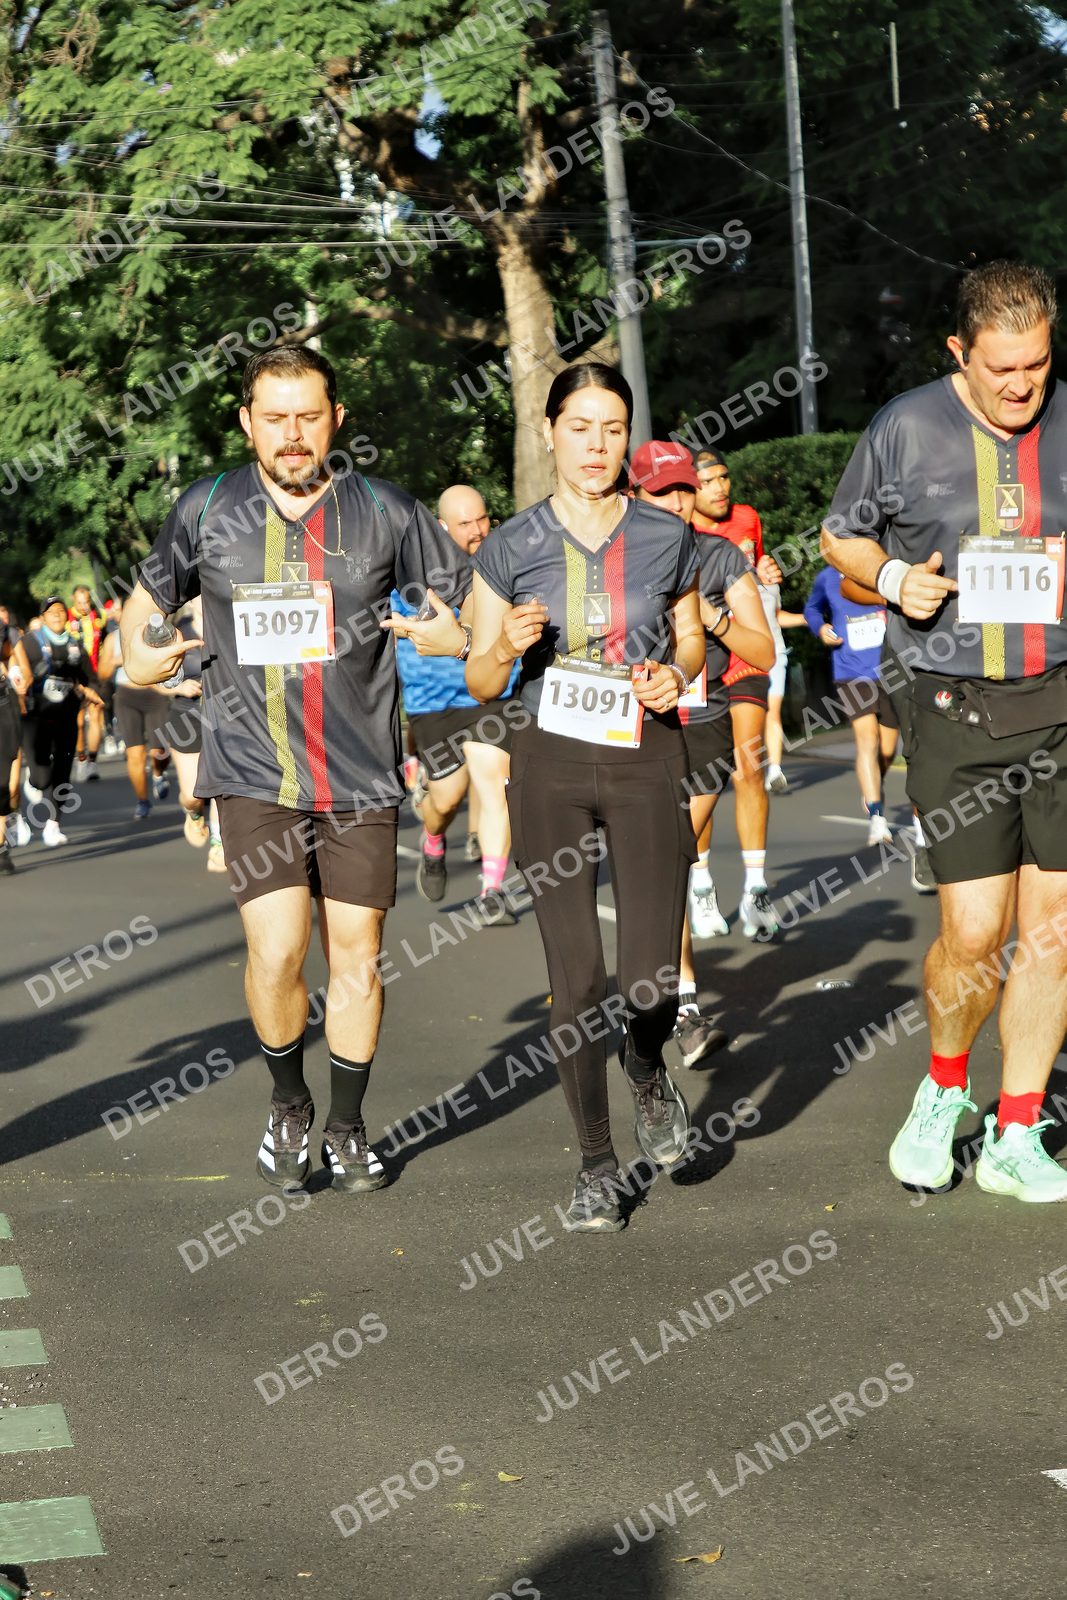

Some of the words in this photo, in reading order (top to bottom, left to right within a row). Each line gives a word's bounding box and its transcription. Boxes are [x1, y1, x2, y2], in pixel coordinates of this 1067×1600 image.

[965, 565, 1051, 592] 11116
[239, 609, 319, 637] 13097
[550, 680, 631, 717] 13091
